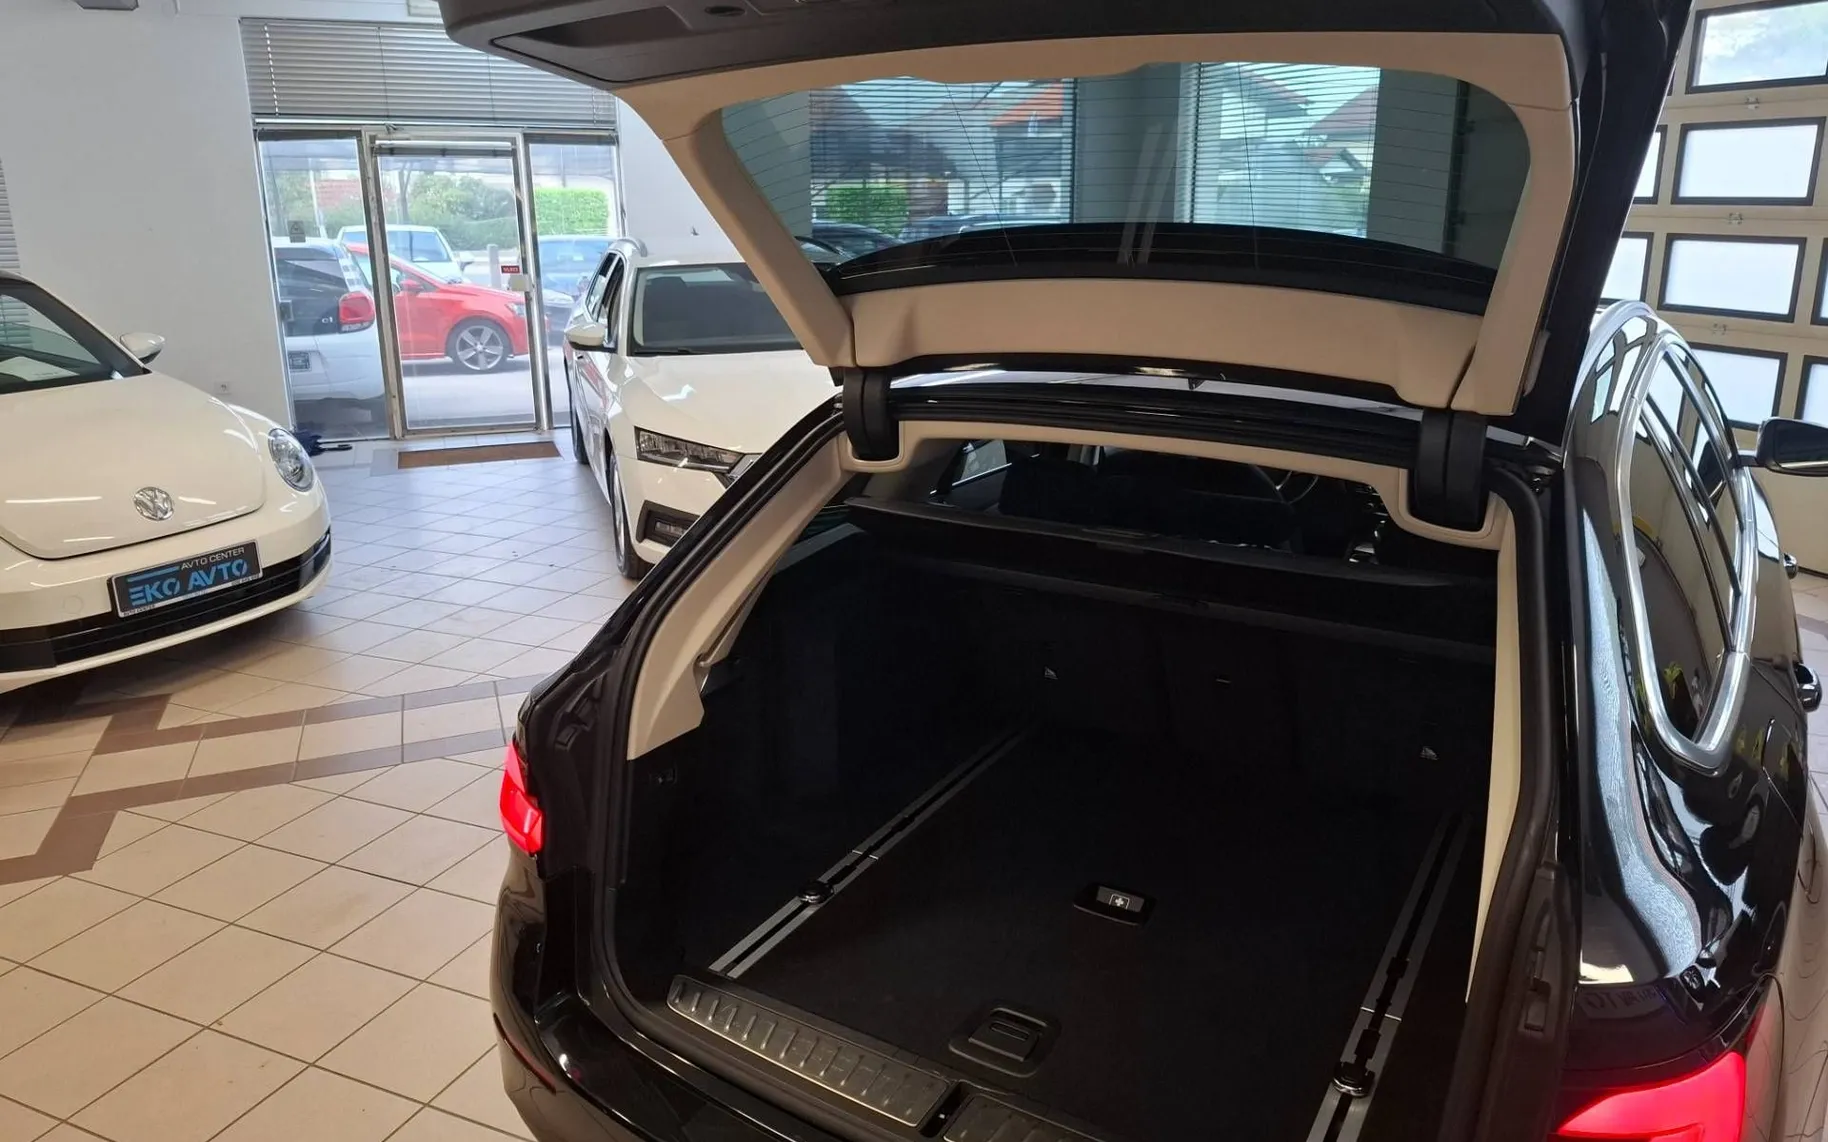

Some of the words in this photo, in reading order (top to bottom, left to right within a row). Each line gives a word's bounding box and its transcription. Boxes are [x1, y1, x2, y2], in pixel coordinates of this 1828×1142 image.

[181, 557, 208, 571] AVTO
[208, 547, 245, 563] CENTER
[128, 577, 181, 606] EKO
[188, 558, 248, 591] AVTO
